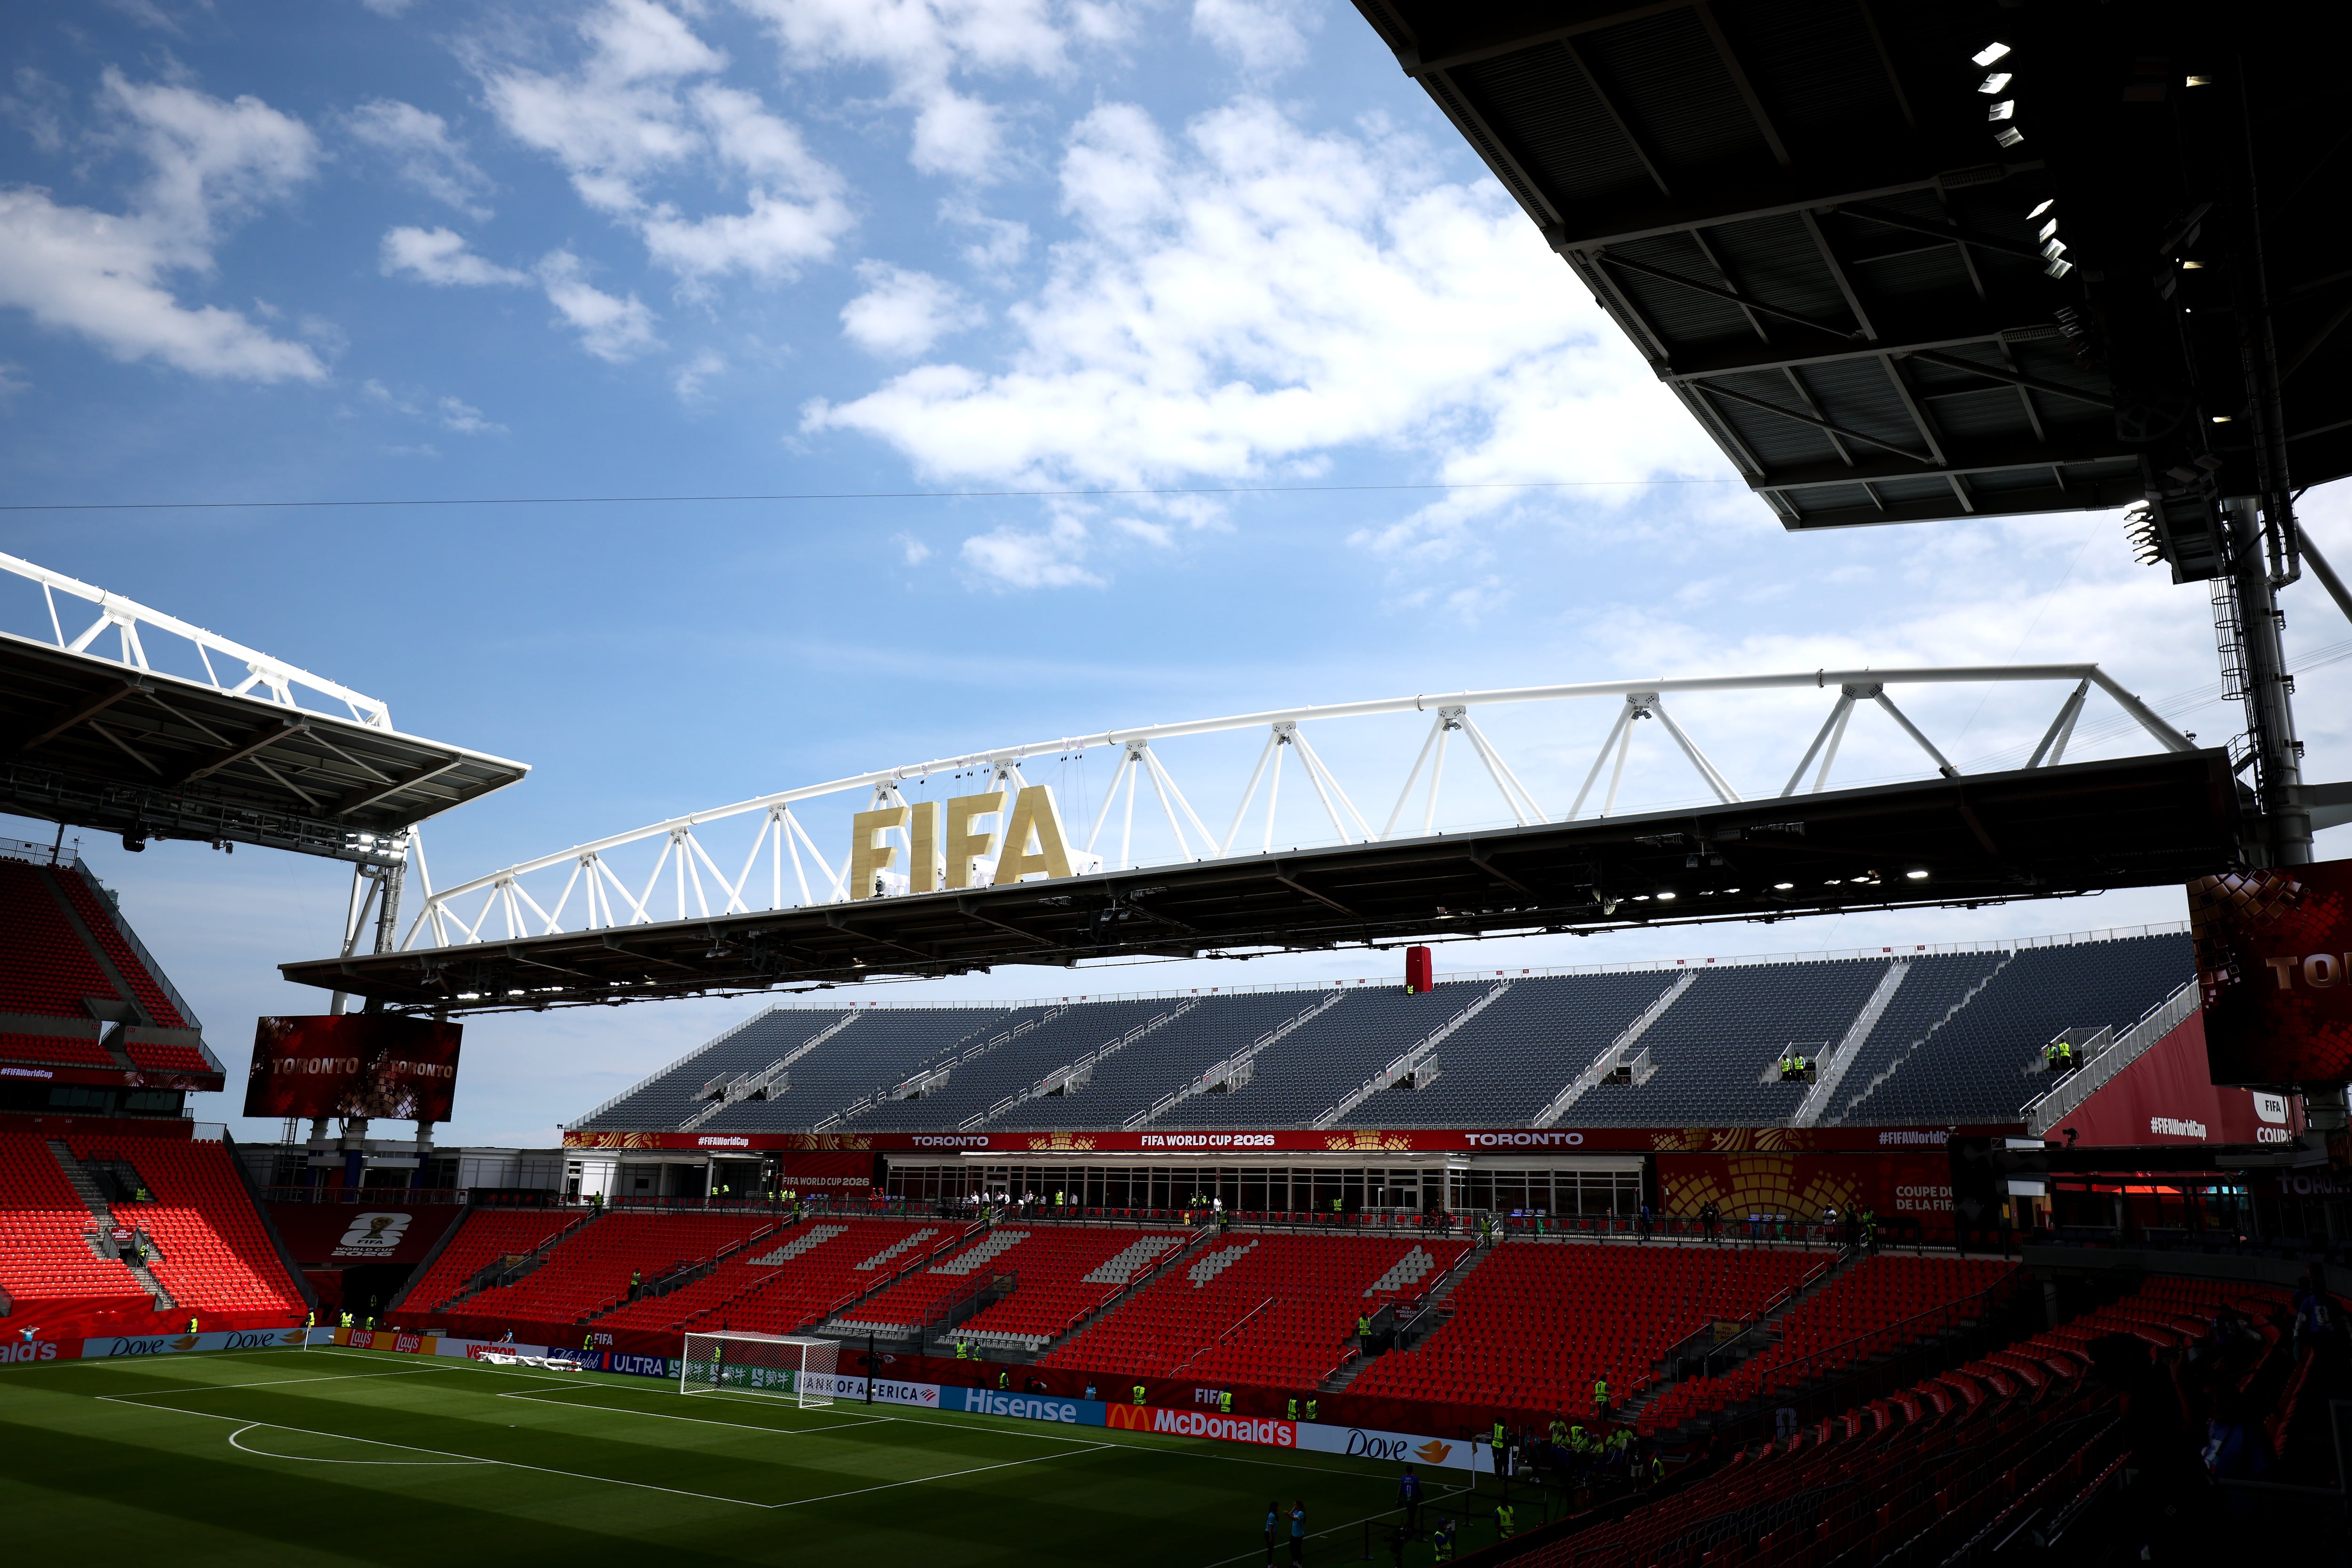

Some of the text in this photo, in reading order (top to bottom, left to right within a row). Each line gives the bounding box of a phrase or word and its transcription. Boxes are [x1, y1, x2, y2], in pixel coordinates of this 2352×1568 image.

[850, 785, 1075, 900] FIFA
[2266, 952, 2352, 990] TO
[0, 1068, 53, 1078] #FIFAWorldCup
[272, 1057, 359, 1075] TORONTO
[390, 1060, 453, 1078] TORONTO
[2265, 1100, 2281, 1113] FIFA
[2151, 1117, 2207, 1140] #FIFAWorldCup
[698, 1136, 749, 1148] #FIFAWorldCup
[912, 1136, 989, 1146] TORONTO
[1141, 1134, 1275, 1146] FIFA WORLD CUP 2026
[1465, 1133, 1583, 1145] TORONTO
[783, 1177, 870, 1186] FIFA WORLD CUP 2026
[1896, 1186, 1937, 1197] COUPE
[1896, 1199, 1955, 1211] DE LA FIF
[109, 1337, 164, 1356] Dove
[224, 1330, 274, 1350] Dove
[350, 1328, 372, 1347] Lay's
[396, 1333, 419, 1353] Lay's
[594, 1333, 613, 1346] FIFA
[614, 1354, 663, 1376] ULTRA
[766, 1370, 789, 1389] 蒙牛
[837, 1380, 853, 1394] OF
[965, 1388, 1077, 1423] Hisense
[1154, 1409, 1292, 1445] McDonald's
[1345, 1428, 1407, 1461] Dove
